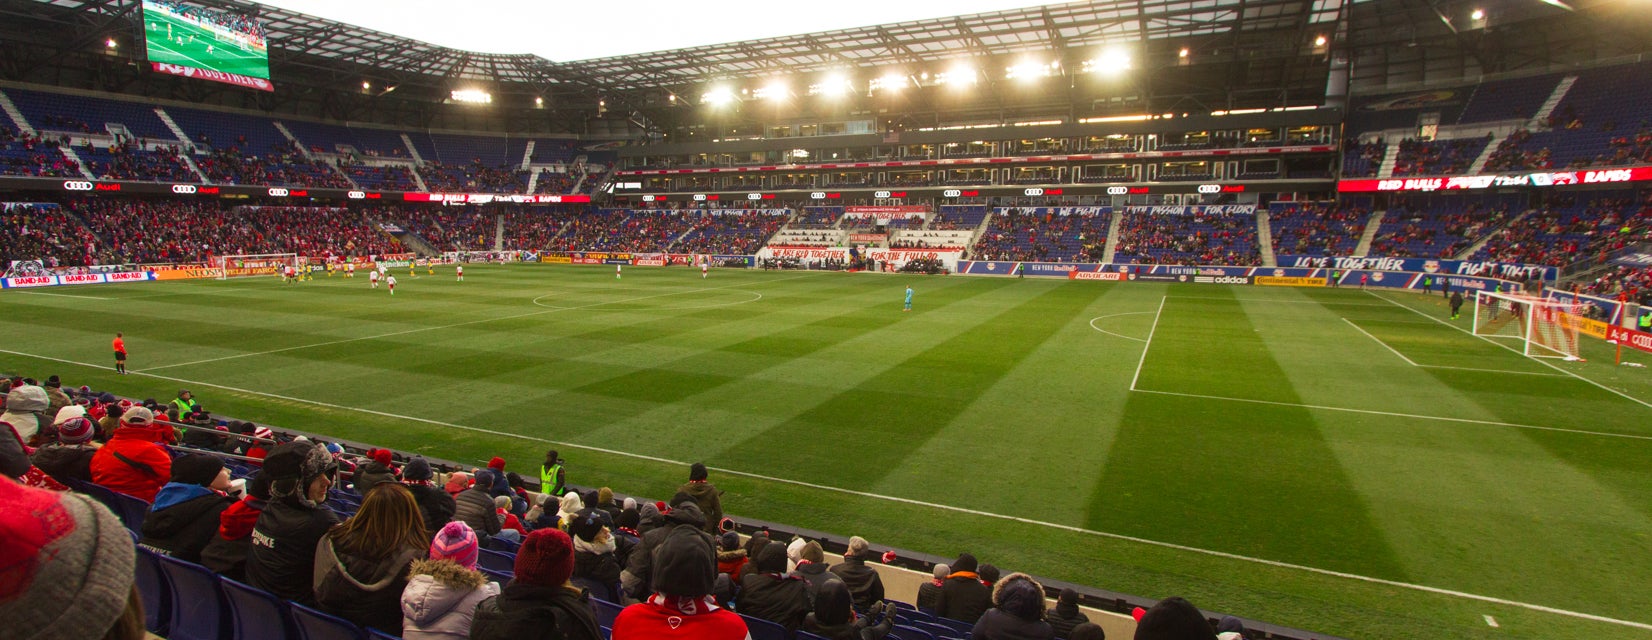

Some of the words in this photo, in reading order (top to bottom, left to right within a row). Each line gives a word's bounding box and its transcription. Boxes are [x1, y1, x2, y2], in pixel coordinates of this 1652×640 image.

[1584, 169, 1632, 183] RAPIDS
[95, 183, 120, 191] Audi
[1377, 180, 1403, 190] RED
[1404, 178, 1442, 189] BULLS
[198, 186, 219, 194] Audi
[961, 189, 979, 197] Audi
[1044, 188, 1063, 196] Audi
[1129, 186, 1149, 194] Audi
[1222, 185, 1245, 193] Audi
[1150, 206, 1186, 216] PASSION
[1203, 205, 1223, 215] FOR
[1225, 205, 1256, 214] GLORY
[811, 250, 846, 258] TOGETHER
[871, 251, 886, 260] FOR
[888, 251, 901, 260] THE
[1294, 256, 1330, 268] LOVE
[1334, 257, 1405, 270] TOGETHER
[65, 273, 98, 282] BAND-AID
[111, 272, 142, 280] BAND-AID
[1078, 272, 1118, 280] ADVOCARE
[1214, 275, 1249, 284] adidas
[14, 276, 51, 285] BAND-AID
